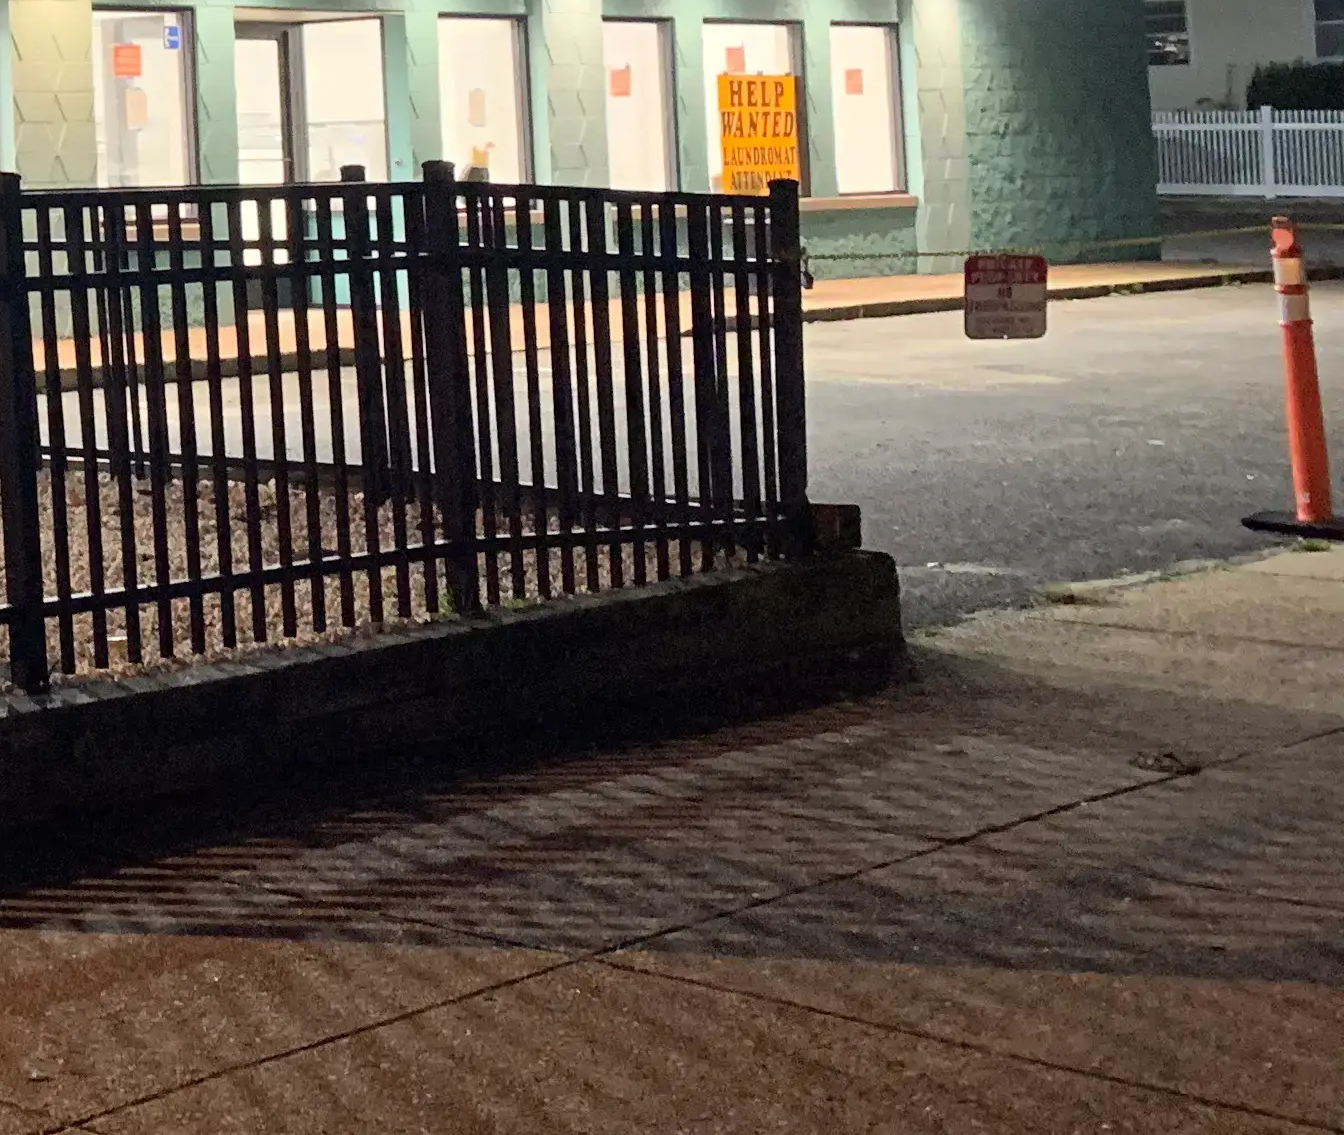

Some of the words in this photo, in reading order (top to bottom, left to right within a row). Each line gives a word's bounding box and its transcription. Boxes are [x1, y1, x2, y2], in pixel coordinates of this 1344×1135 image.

[729, 80, 784, 107] HELP
[721, 111, 794, 138] WANTED
[723, 145, 796, 166] LAUNDROMAT
